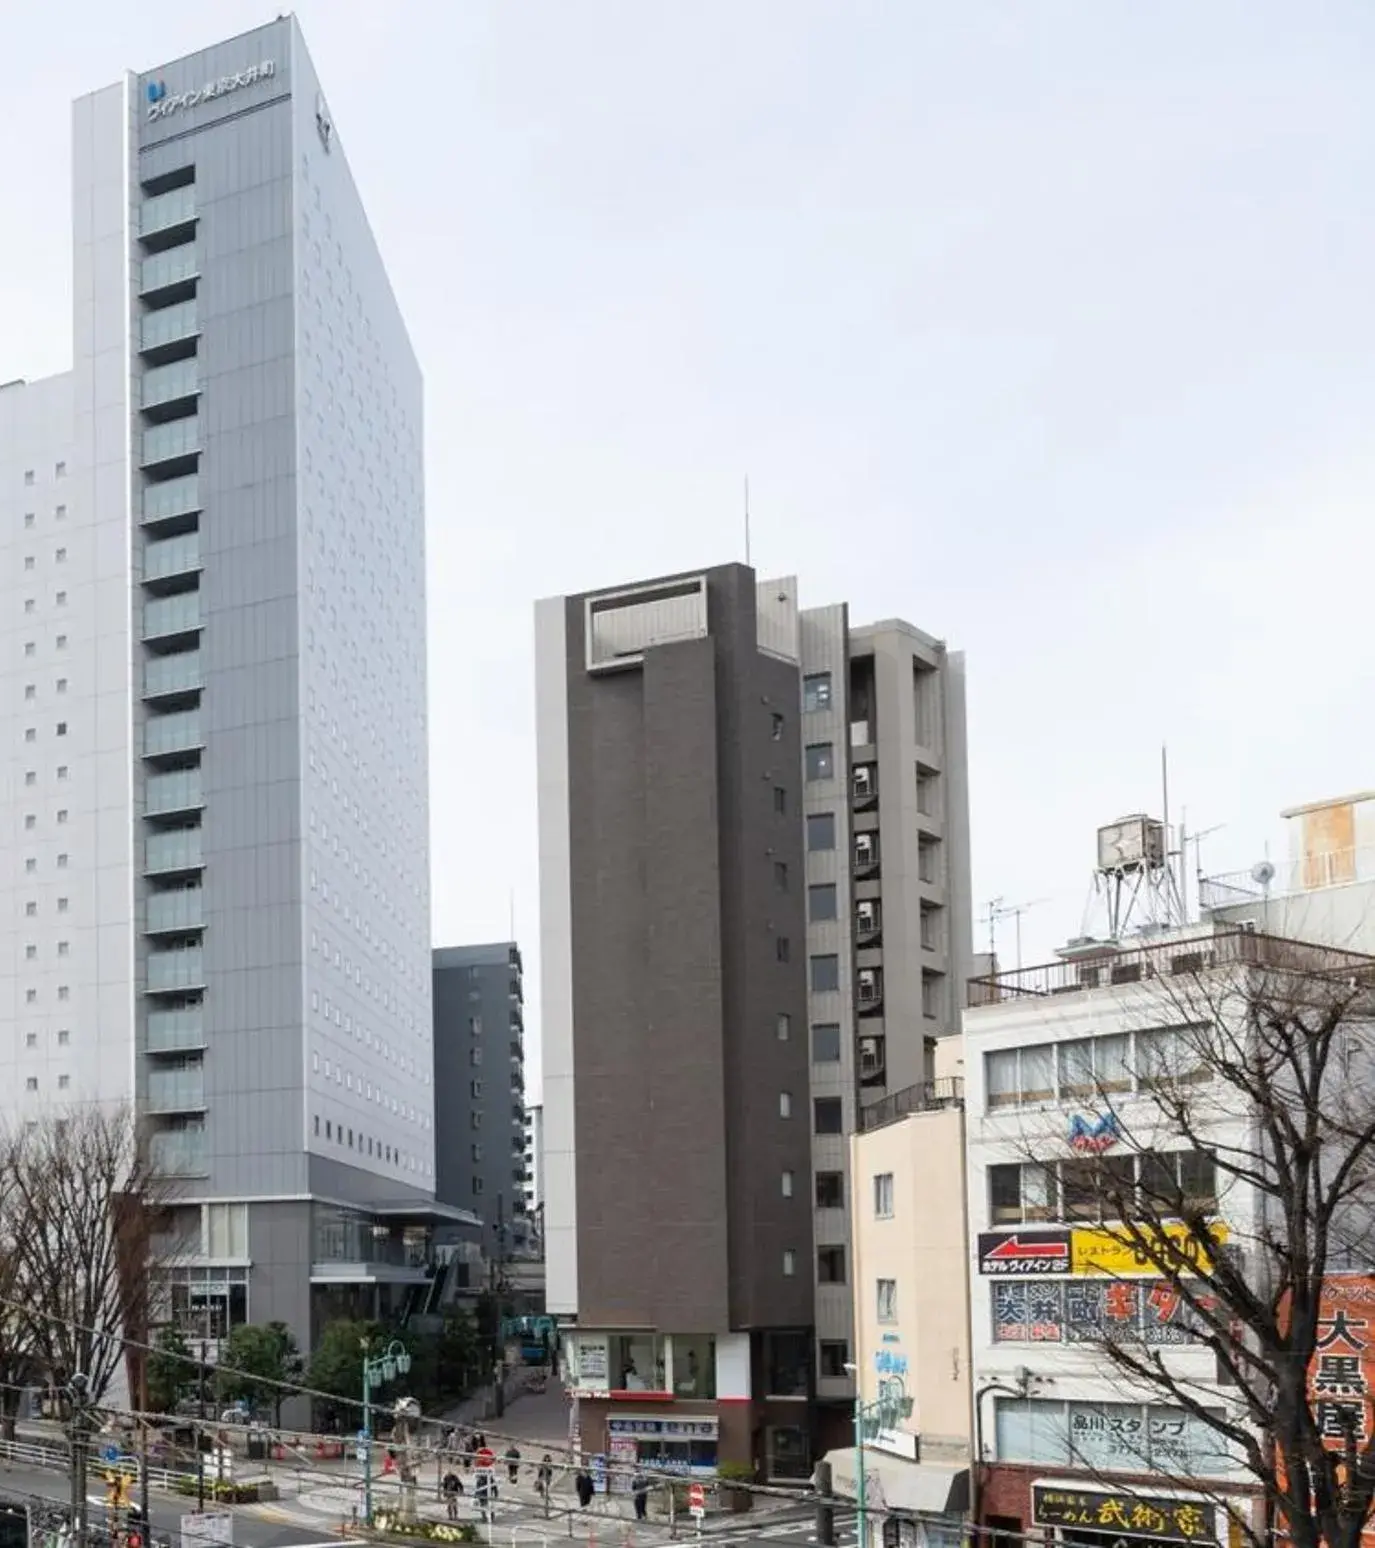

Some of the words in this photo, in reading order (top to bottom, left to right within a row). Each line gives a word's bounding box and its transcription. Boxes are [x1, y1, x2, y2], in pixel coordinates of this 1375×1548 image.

[1038, 1503, 1093, 1524] らーめん
[1095, 1497, 1204, 1537] 武術家
